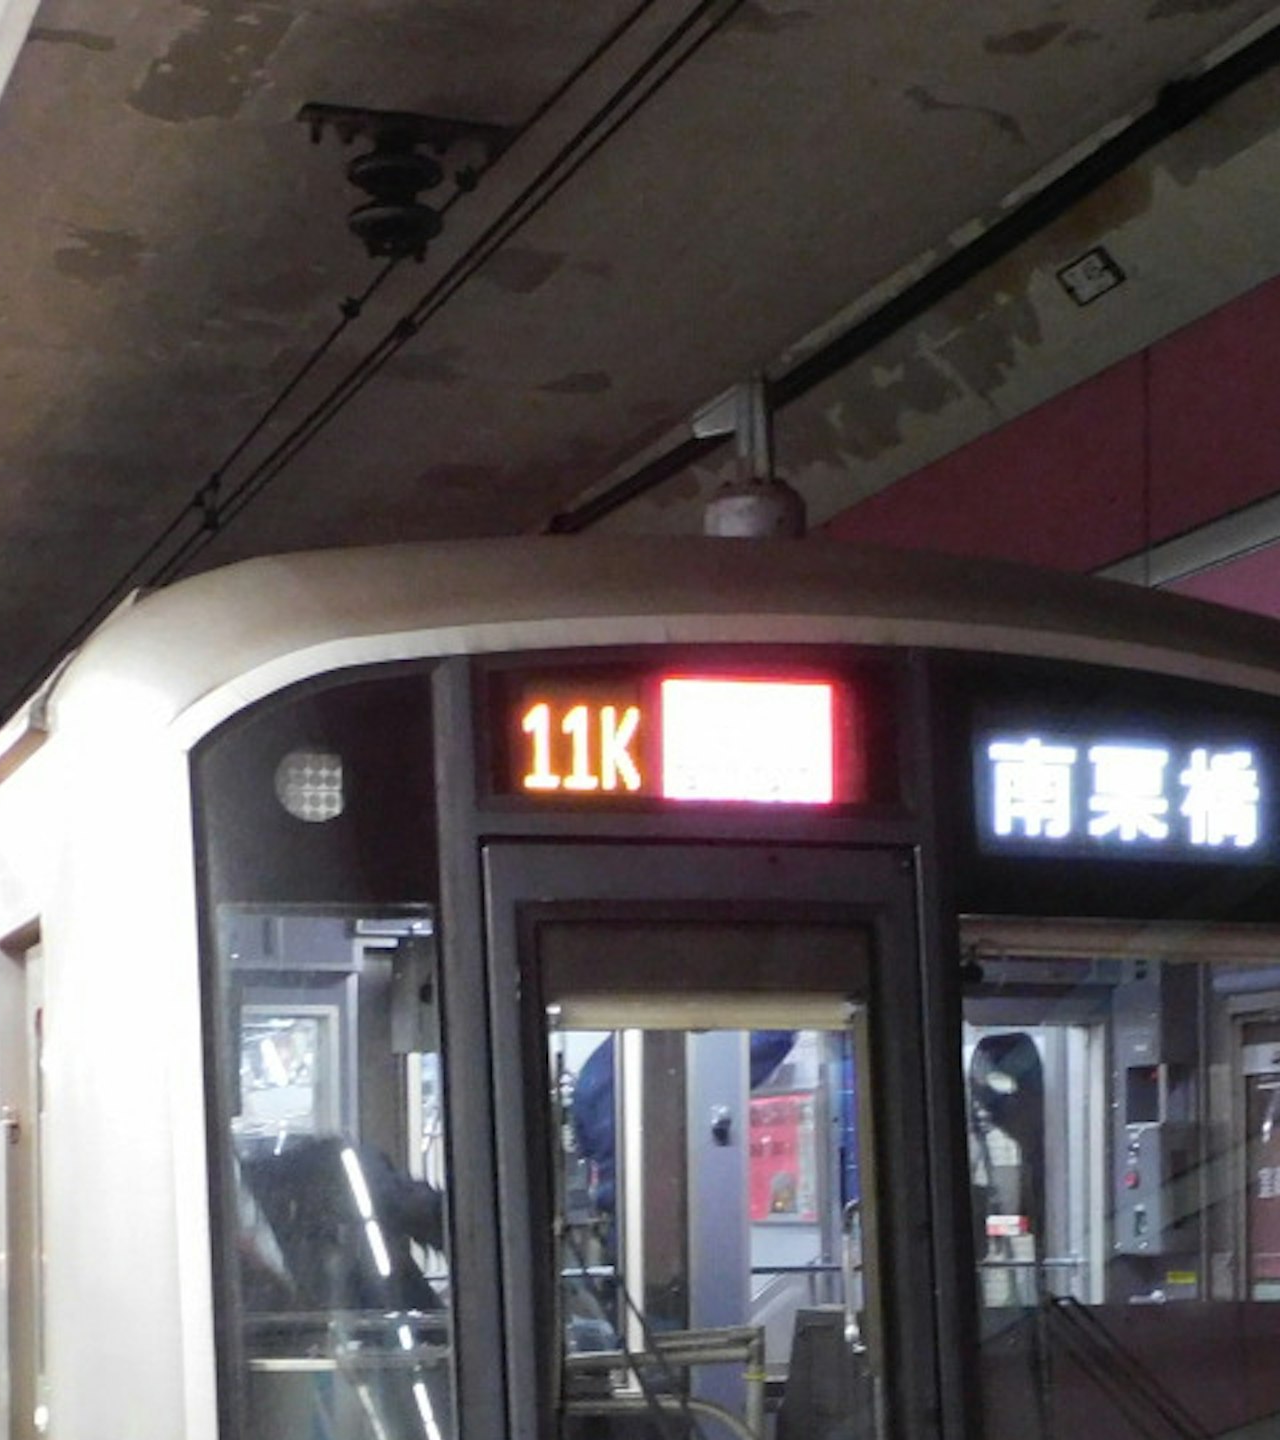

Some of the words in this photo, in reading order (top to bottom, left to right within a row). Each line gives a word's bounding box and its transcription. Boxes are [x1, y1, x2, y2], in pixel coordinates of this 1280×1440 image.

[521, 703, 642, 790] 11K
[987, 737, 1261, 848] 南栗橋
